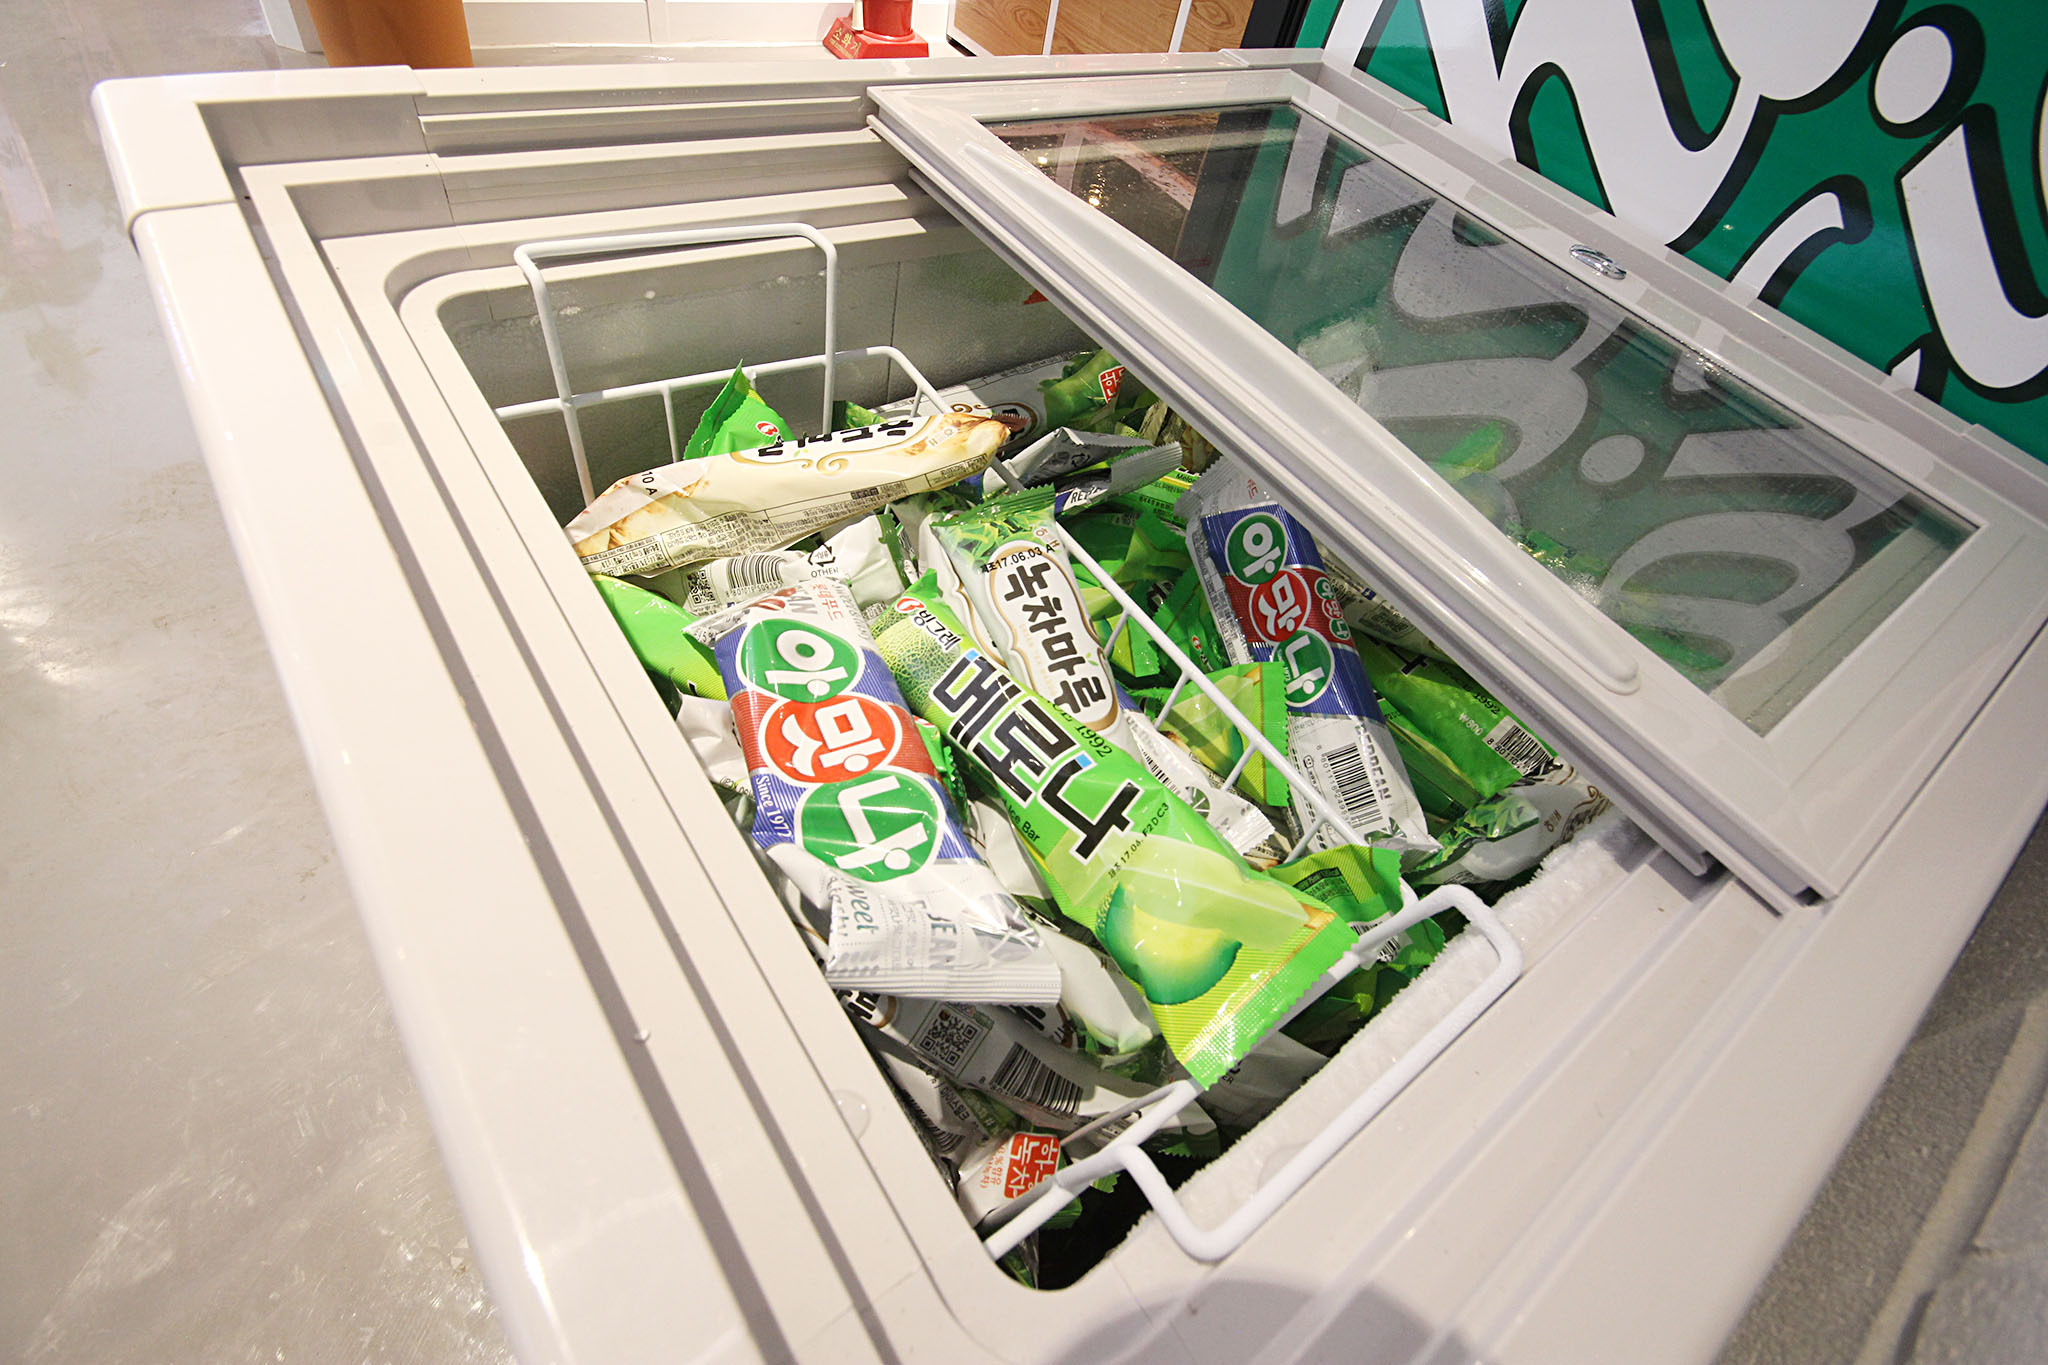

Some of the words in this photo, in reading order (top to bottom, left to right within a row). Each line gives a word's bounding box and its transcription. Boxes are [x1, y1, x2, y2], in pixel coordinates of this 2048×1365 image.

[832, 27, 862, 57] 소화기
[912, 608, 961, 650] 빙그레
[1004, 562, 1107, 715] 녹차마루
[1474, 693, 1501, 715] 1992
[765, 629, 928, 870] 아맛나
[930, 650, 1144, 864] 메로나
[1075, 725, 1112, 758] 1992
[756, 775, 774, 808] Since
[767, 809, 793, 838] 1977
[1022, 820, 1040, 842] Bar
[1007, 1137, 1041, 1197] 녹차
